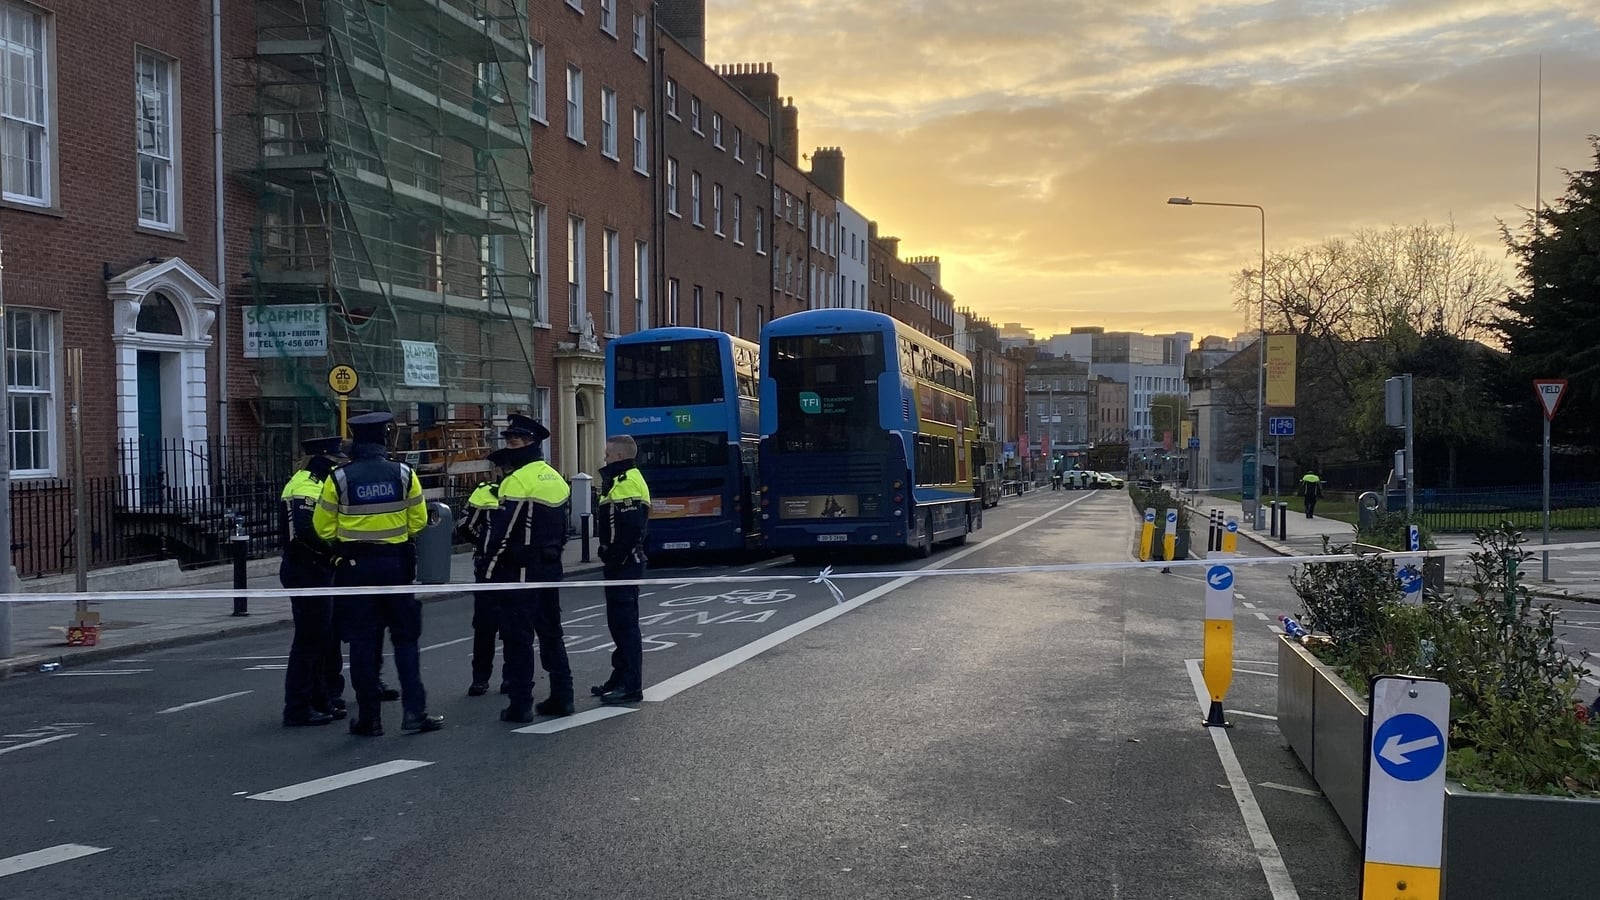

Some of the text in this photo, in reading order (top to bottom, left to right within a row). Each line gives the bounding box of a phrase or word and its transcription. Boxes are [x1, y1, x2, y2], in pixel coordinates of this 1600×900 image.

[246, 309, 320, 325] SCAFHIRE
[259, 340, 273, 348] TEL
[304, 338, 324, 347] 6071
[1540, 385, 1561, 394] YIELD
[802, 398, 819, 407] TFI
[675, 415, 691, 423] TFI
[356, 484, 395, 498] GARDA
